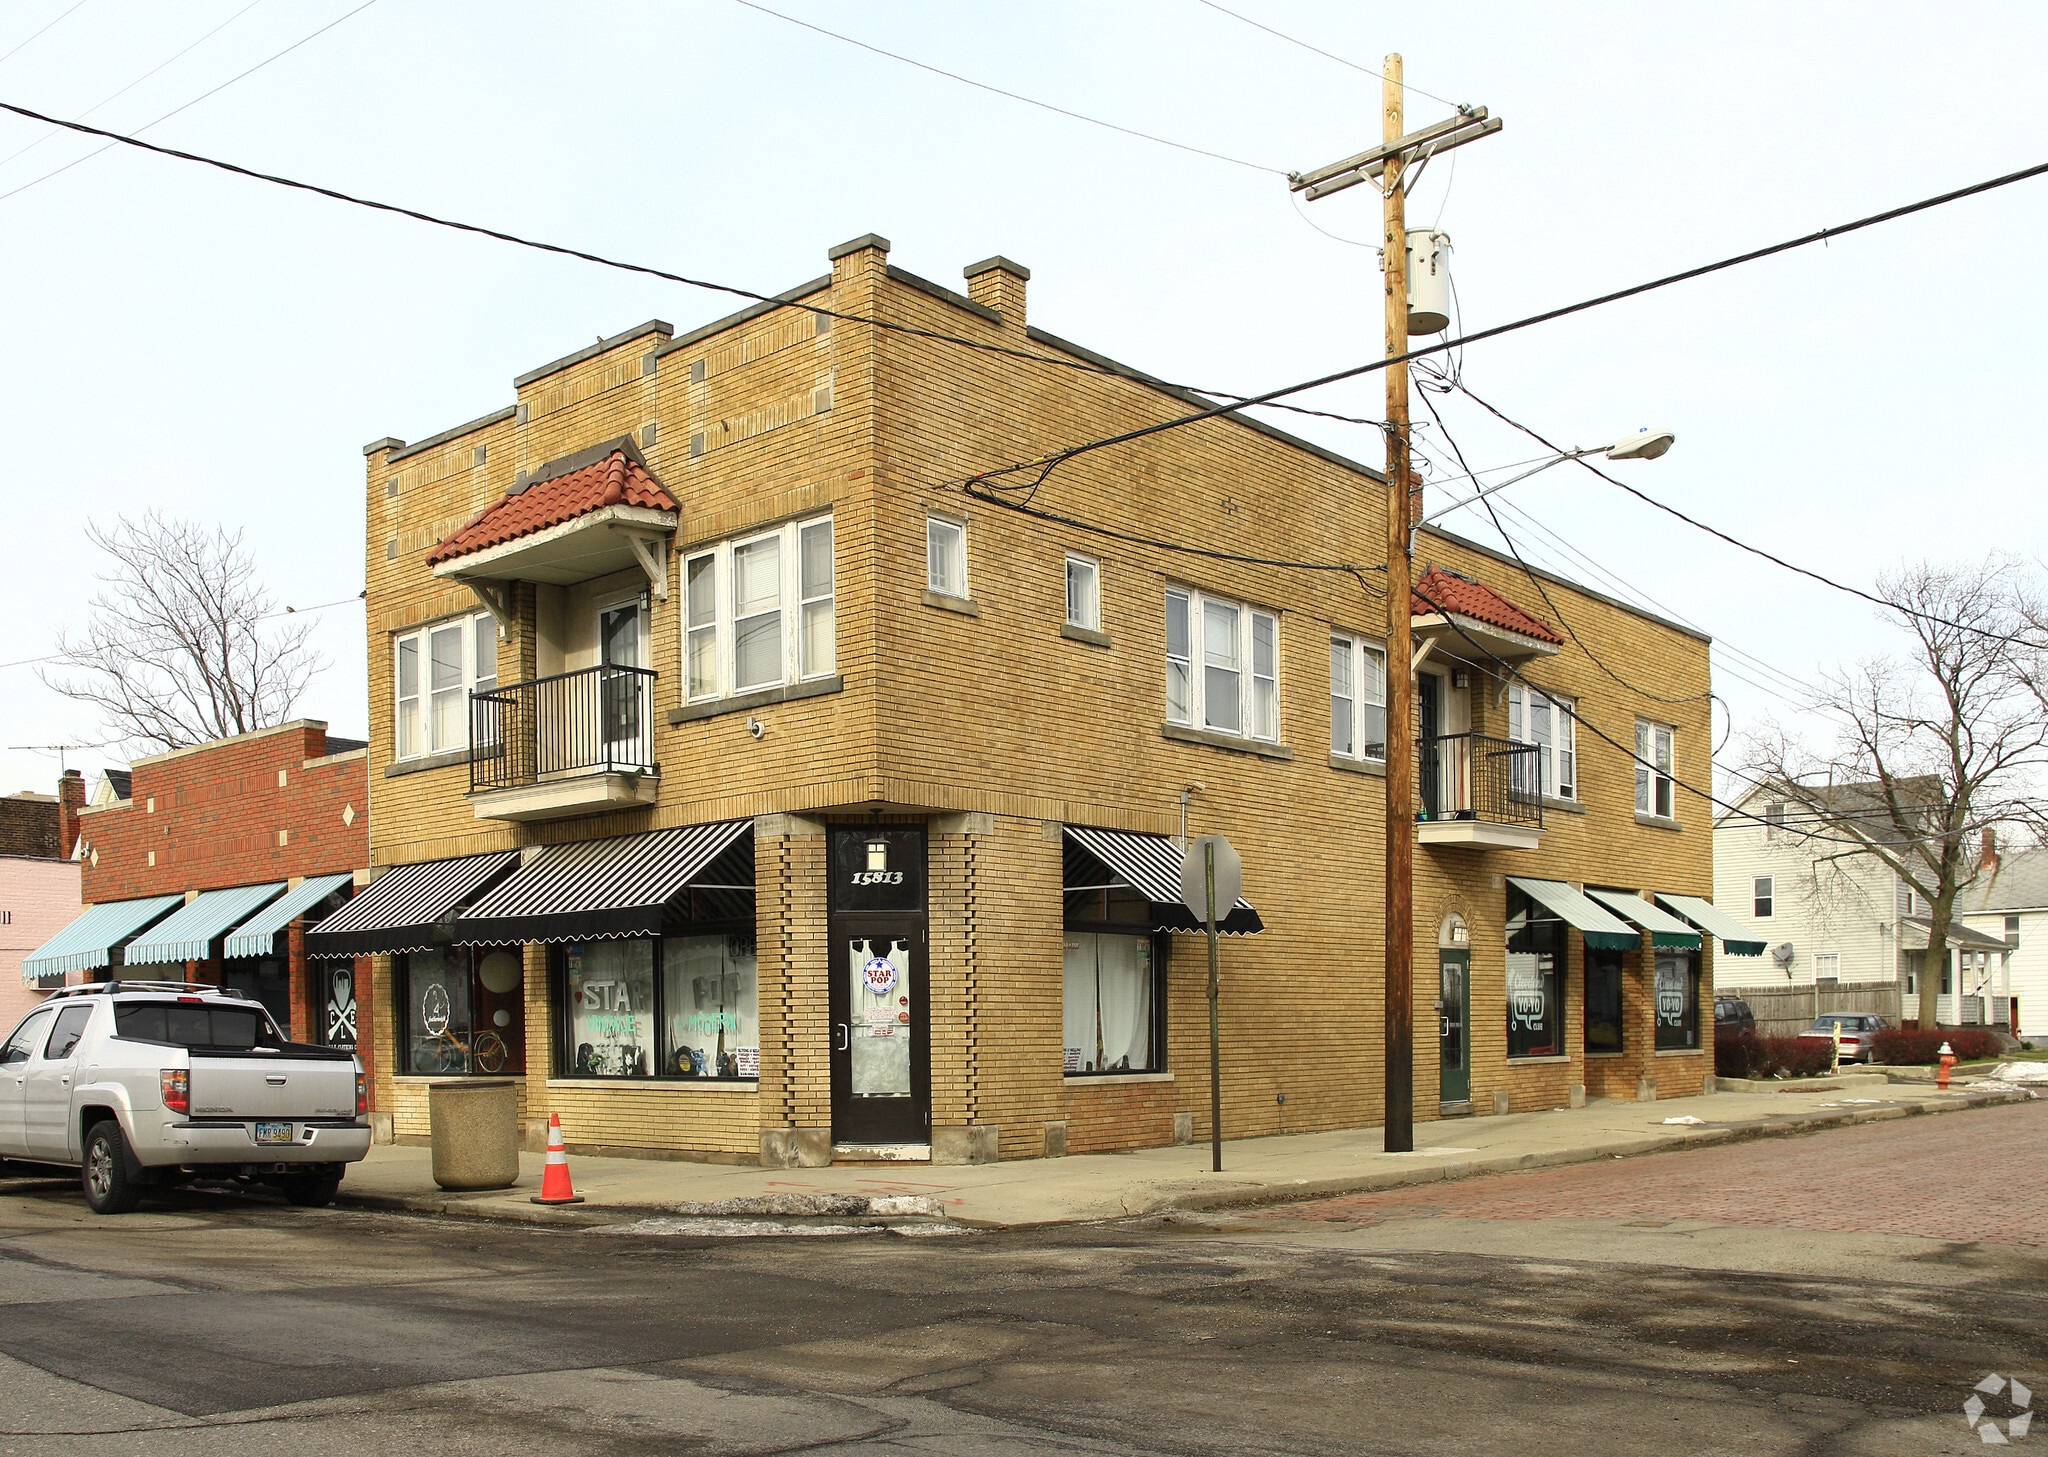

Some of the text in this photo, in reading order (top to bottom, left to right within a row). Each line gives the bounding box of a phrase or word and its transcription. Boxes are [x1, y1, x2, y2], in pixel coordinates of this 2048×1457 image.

[850, 871, 904, 886] 15813
[867, 970, 892, 978] STAR
[870, 976, 890, 984] POP
[586, 1014, 636, 1033] VINTAGE
[687, 1012, 737, 1032] MODERN
